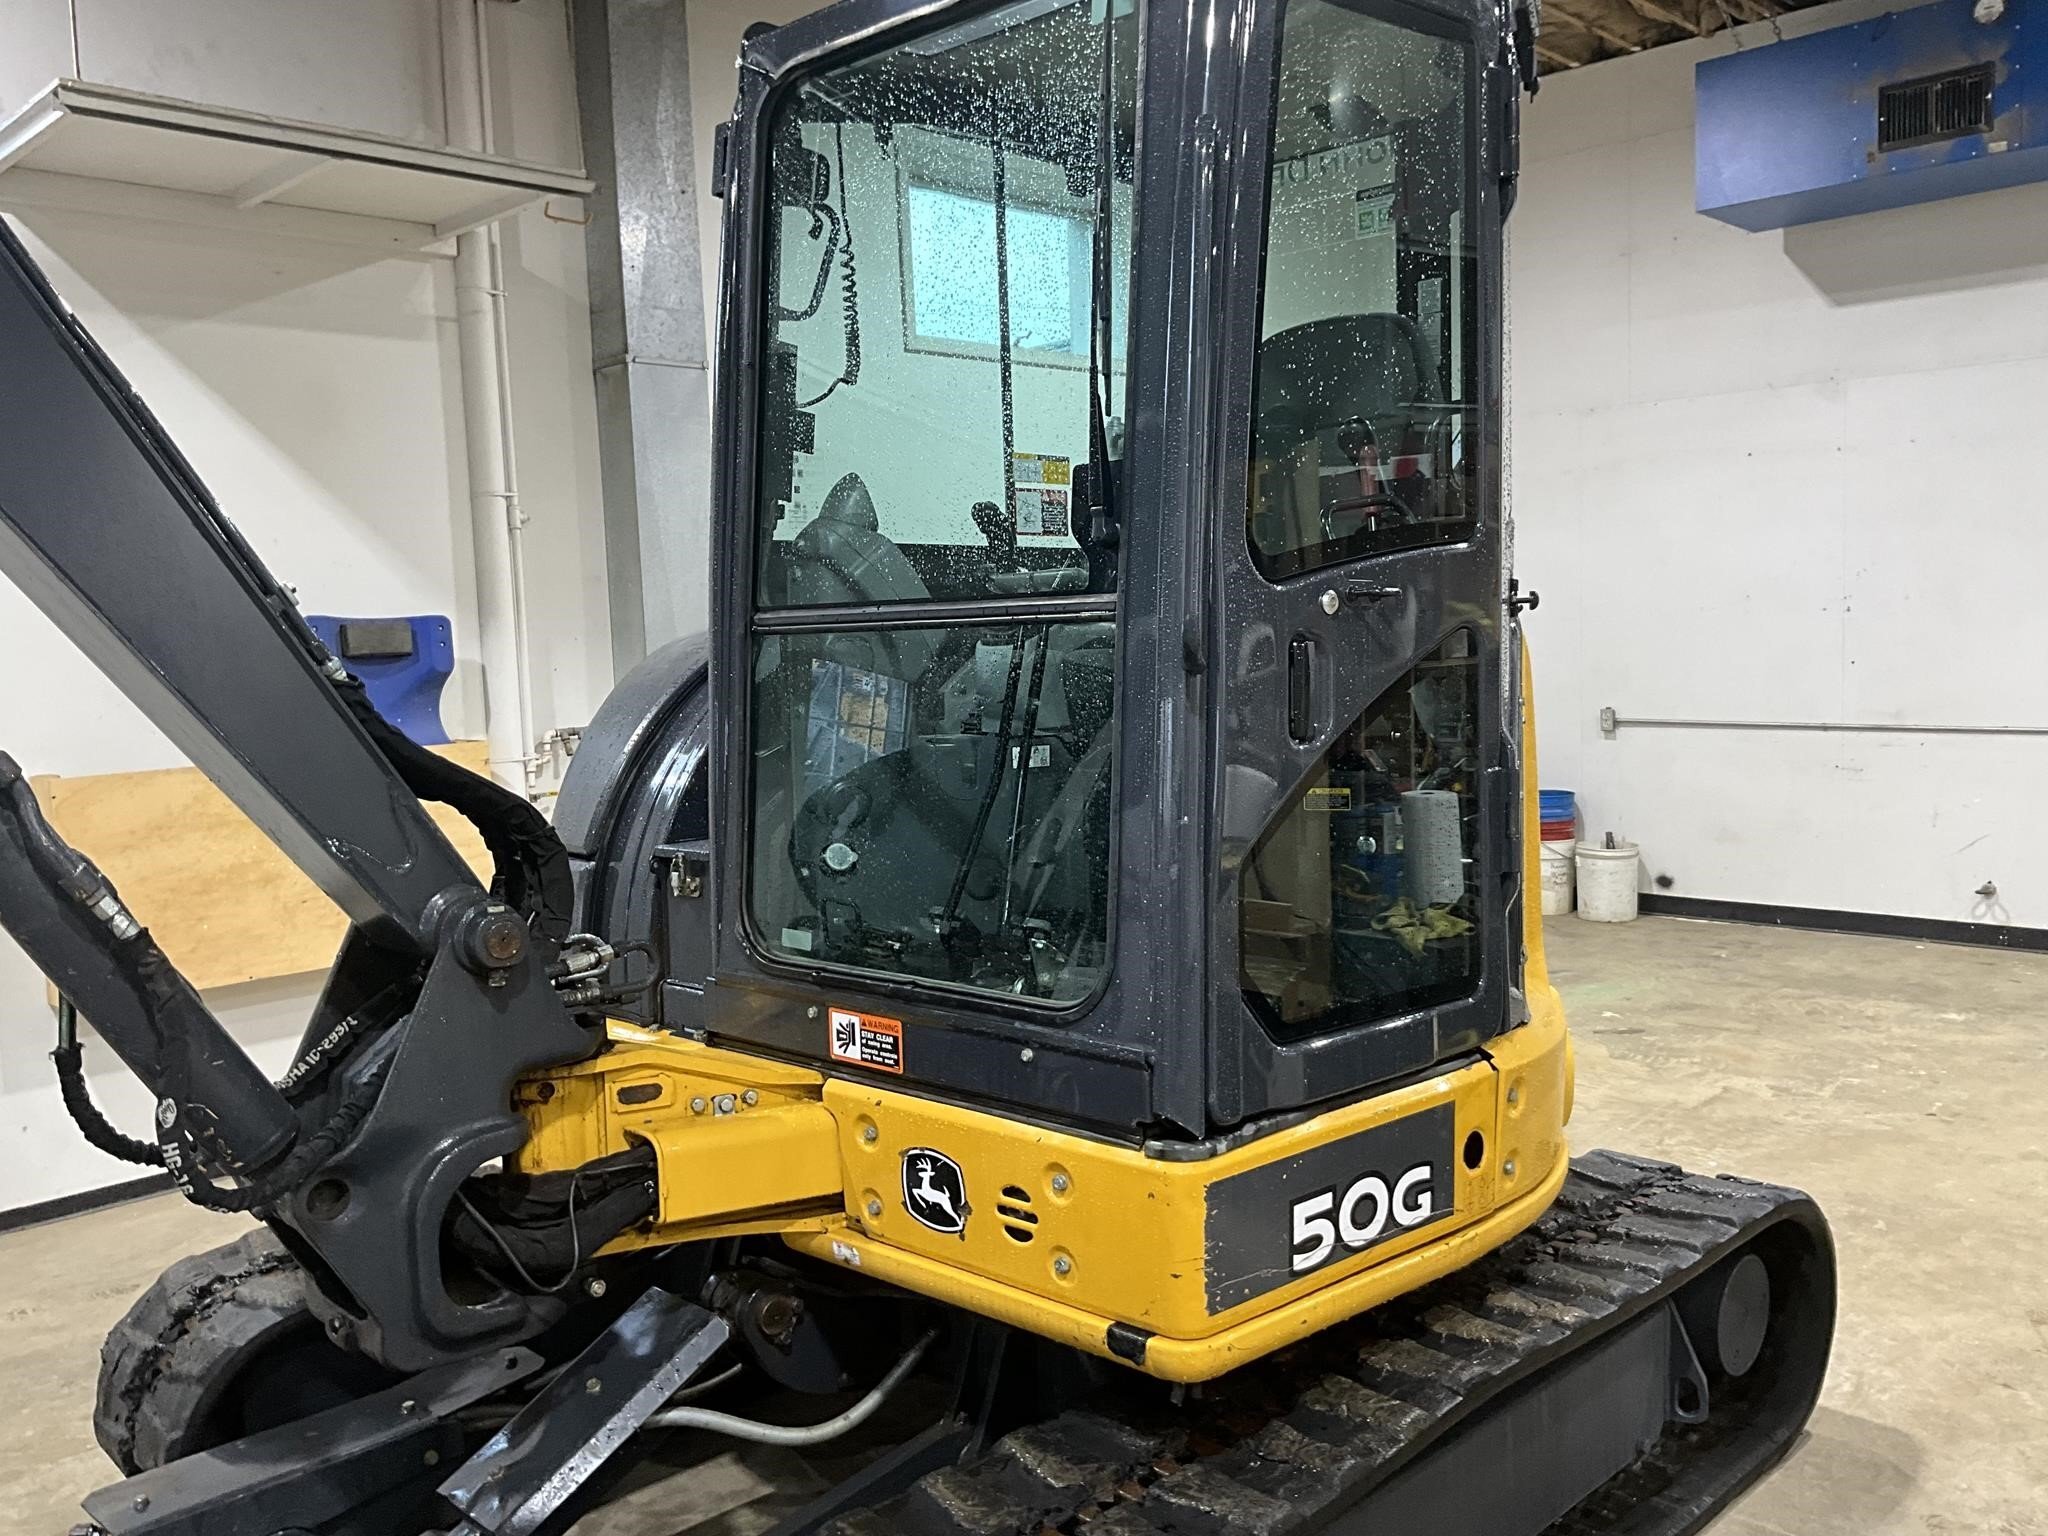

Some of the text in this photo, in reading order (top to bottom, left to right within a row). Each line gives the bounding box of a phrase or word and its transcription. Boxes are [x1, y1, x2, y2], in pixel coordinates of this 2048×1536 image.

[868, 1020, 899, 1034] WARNING
[861, 1030, 893, 1043] STAY CLEAR
[1292, 1164, 1432, 1271] 50G
